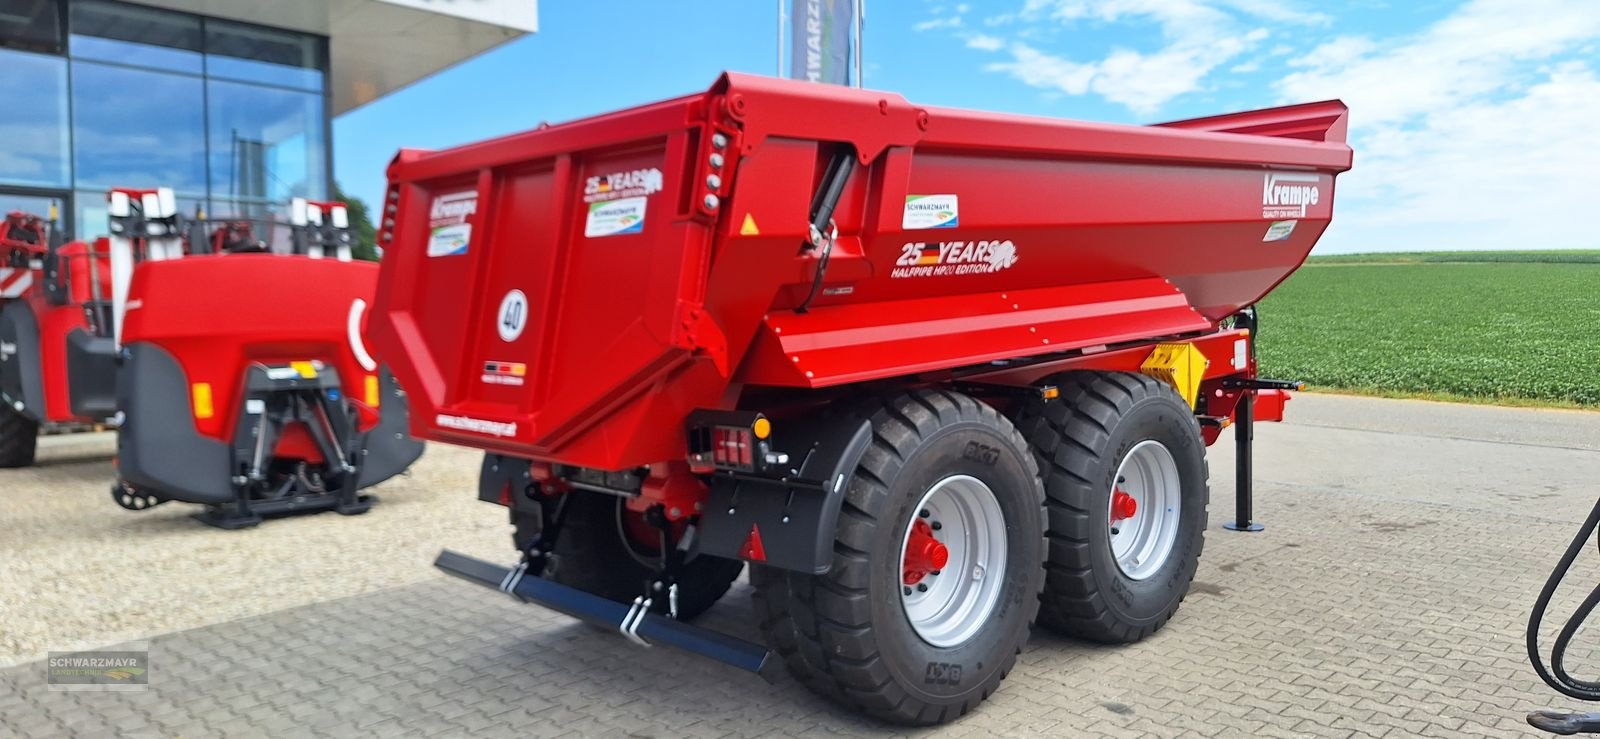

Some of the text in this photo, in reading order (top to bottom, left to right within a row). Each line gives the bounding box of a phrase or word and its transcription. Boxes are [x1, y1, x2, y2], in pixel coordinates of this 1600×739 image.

[607, 170, 649, 191] YEARS
[1263, 173, 1319, 217] Krampe
[895, 240, 1001, 266] 25 YEARS
[890, 266, 933, 278] HALFPIPE
[955, 263, 990, 275] EDITION
[504, 301, 522, 330] 40
[962, 440, 1001, 466] BKT
[924, 662, 962, 686] BKT
